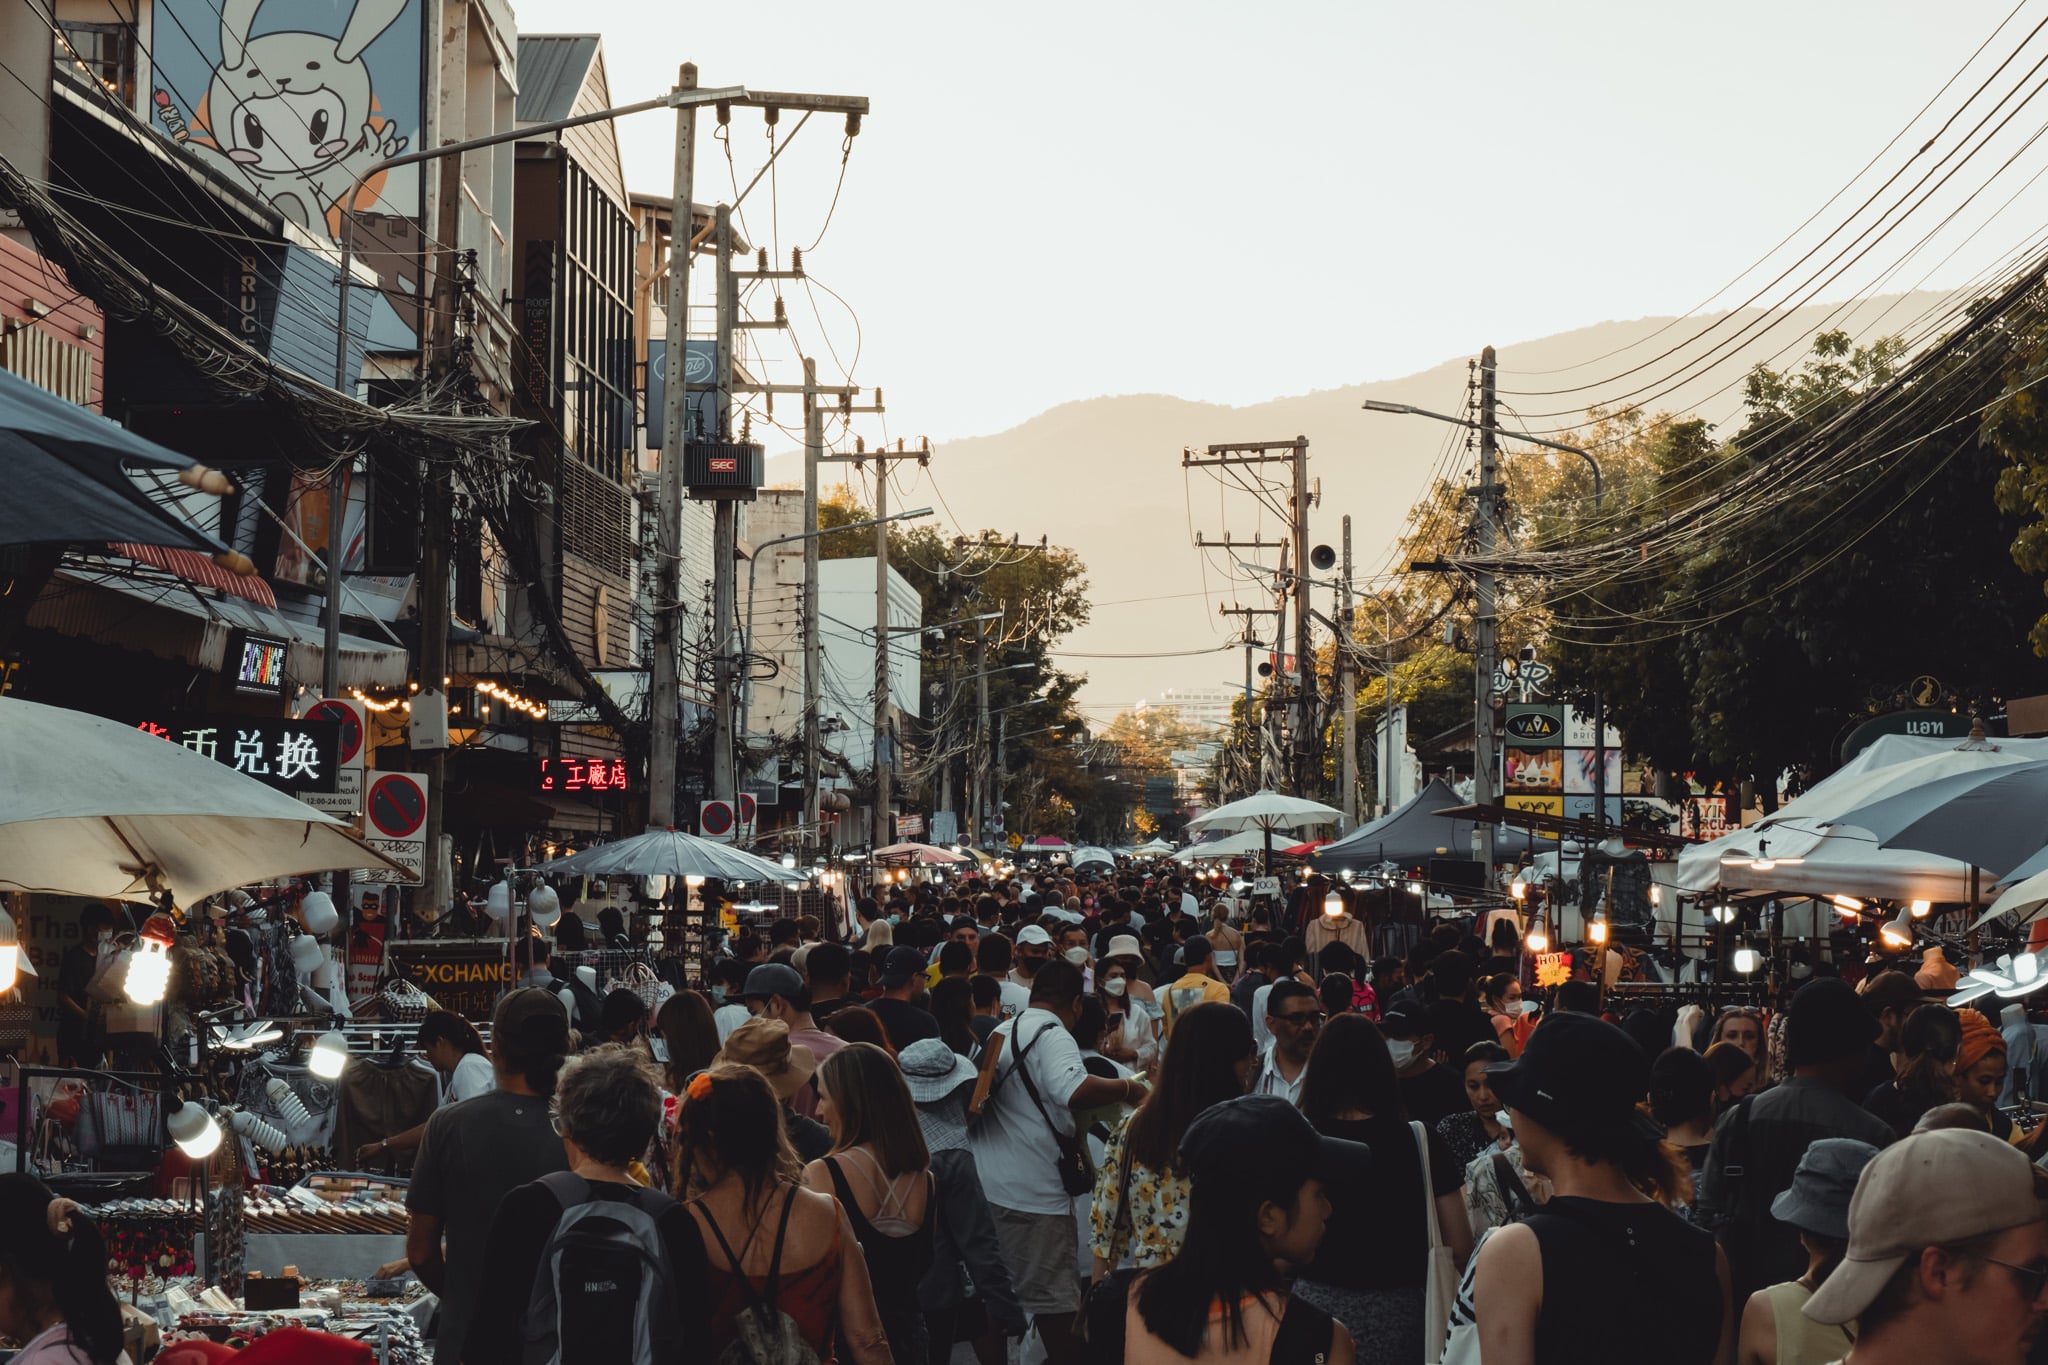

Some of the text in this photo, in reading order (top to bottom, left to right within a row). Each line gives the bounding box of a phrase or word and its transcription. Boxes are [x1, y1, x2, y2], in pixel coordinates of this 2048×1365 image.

[711, 461, 735, 470] SEC
[1516, 716, 1551, 734] VAVA
[138, 721, 321, 779] 币兑换
[30, 915, 79, 939] Tha
[1539, 954, 1561, 966] HOT
